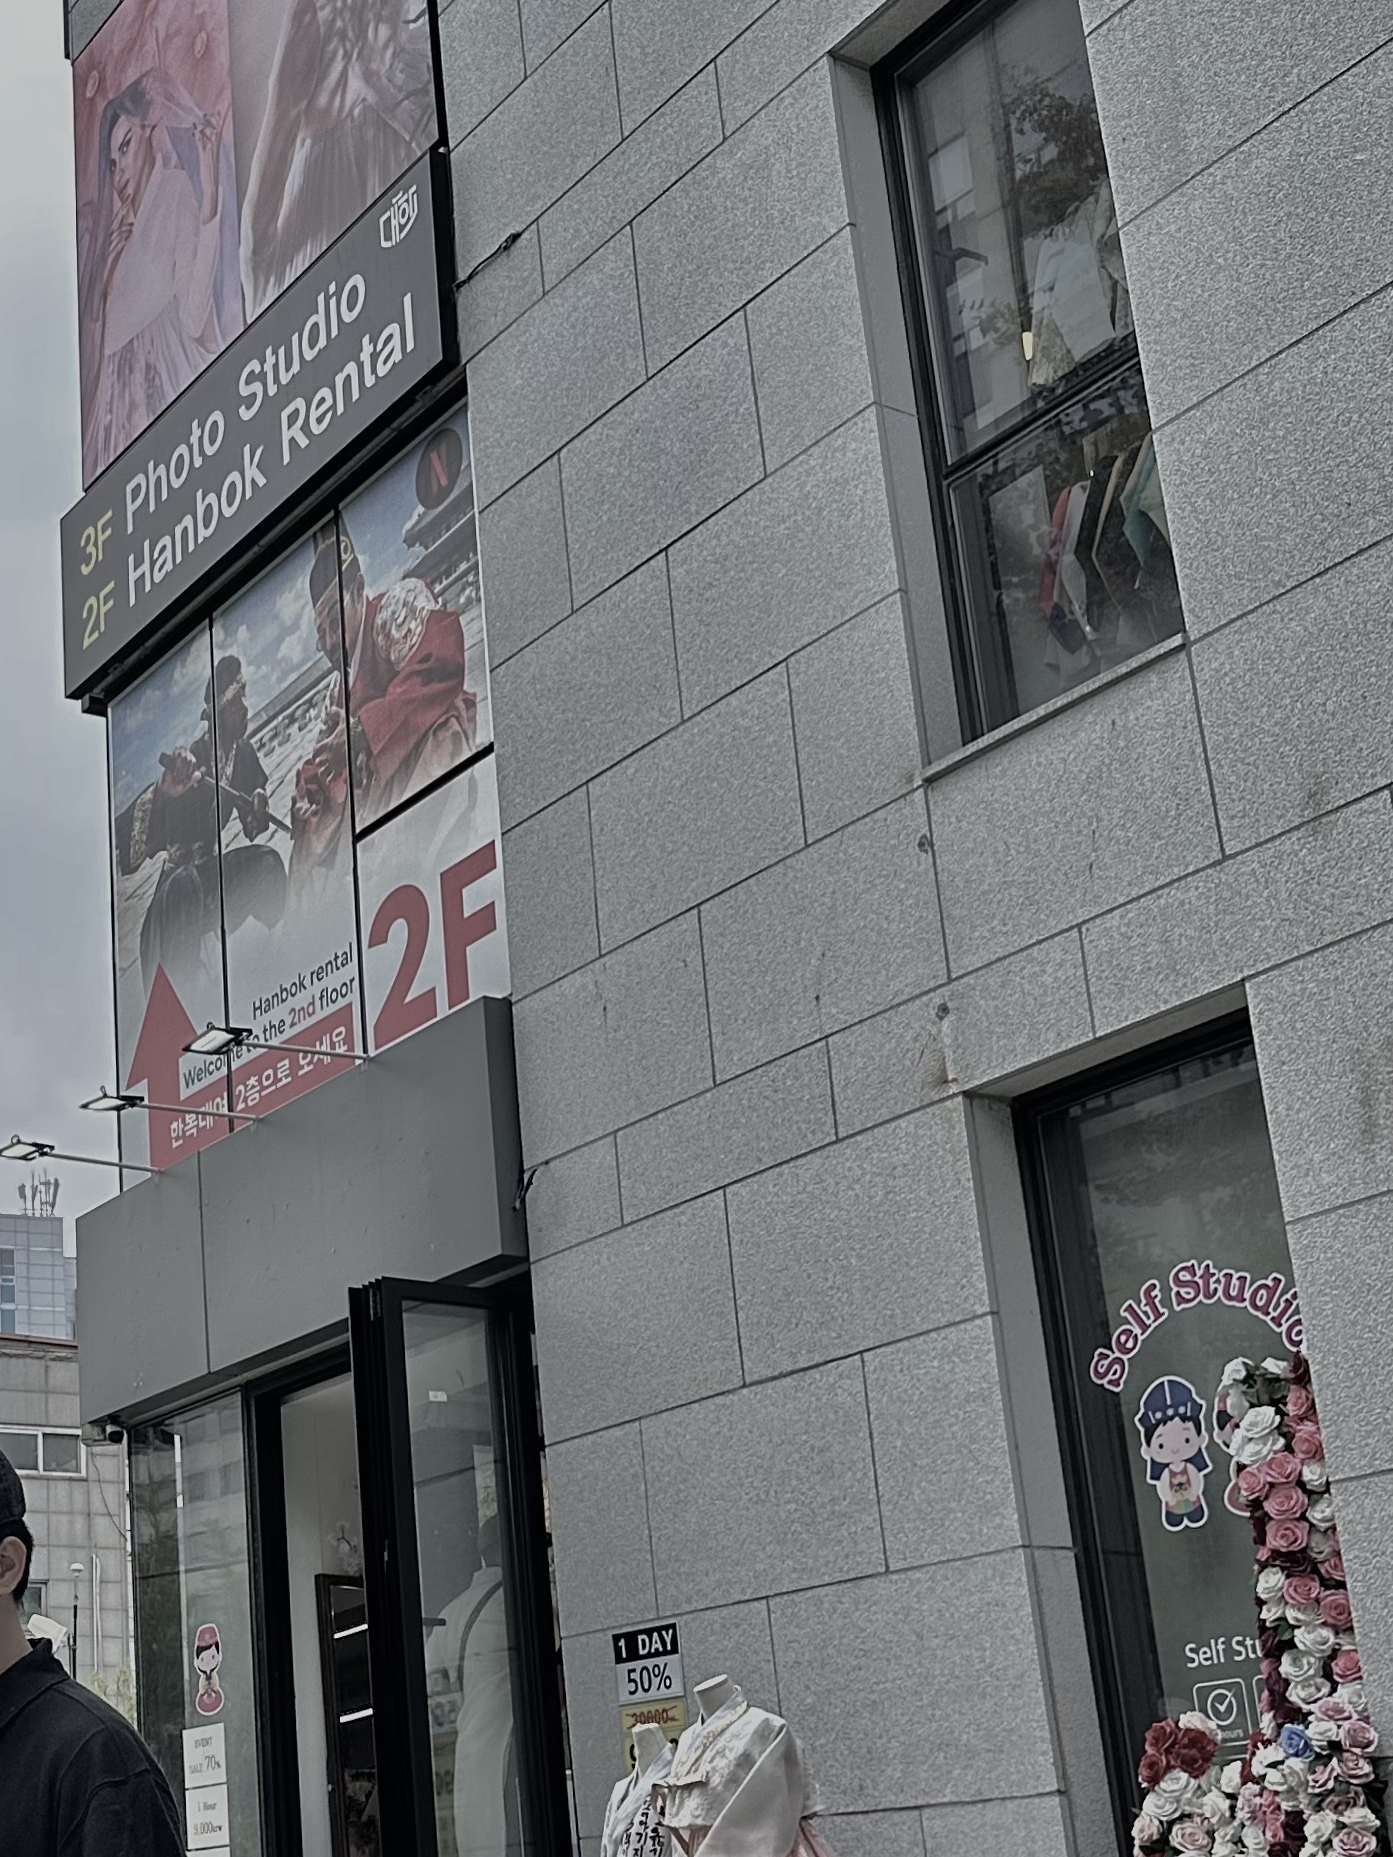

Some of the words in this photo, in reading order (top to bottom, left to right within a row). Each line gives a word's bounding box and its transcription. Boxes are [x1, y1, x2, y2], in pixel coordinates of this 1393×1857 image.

[80, 509, 112, 575] 3F
[126, 410, 225, 535] Photo
[238, 273, 366, 421] Studio
[82, 581, 115, 650] 2F
[128, 443, 267, 607] Hanbok
[280, 292, 415, 466] Rental
[368, 839, 497, 1051] 2F
[252, 973, 308, 1020] Hanbok
[310, 942, 353, 986] rental
[263, 1018, 286, 1043] the
[288, 995, 316, 1029] 2nd
[318, 977, 356, 1011] floor
[236, 1058, 292, 1111] 2층으로
[1091, 1280, 1167, 1391] Self
[1170, 1260, 1306, 1351] Studio
[618, 1638, 627, 1659] 1
[638, 1628, 673, 1656] DAY
[1184, 1637, 1225, 1668] Self
[627, 1662, 672, 1695] 50%
[189, 1762, 204, 1774] SALE
[194, 1736, 213, 1749] EVENT
